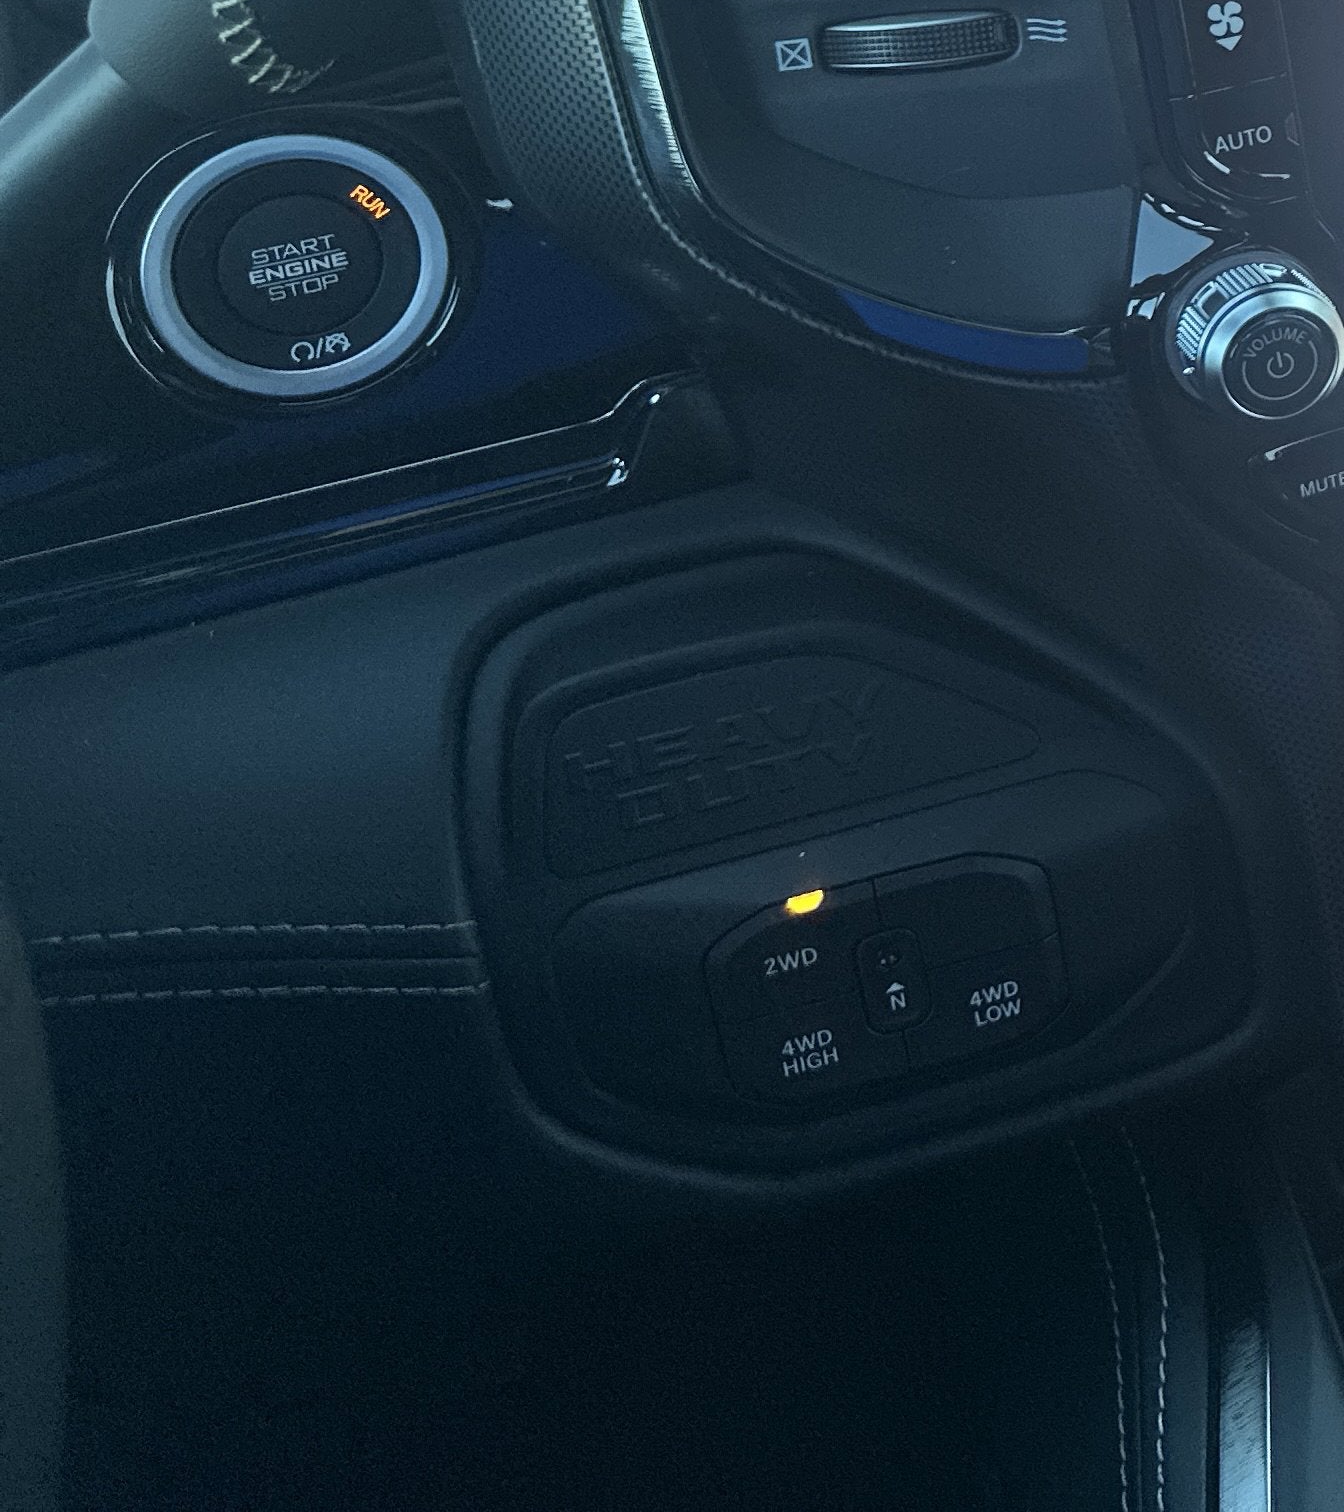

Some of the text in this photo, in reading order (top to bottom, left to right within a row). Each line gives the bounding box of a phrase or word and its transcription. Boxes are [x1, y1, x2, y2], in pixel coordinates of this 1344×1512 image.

[1214, 125, 1273, 155] AUTO
[350, 184, 391, 220] RUN
[251, 234, 335, 265] START
[249, 251, 349, 285] ENGINE
[268, 274, 339, 302] STOP
[1243, 327, 1308, 358] VOLUME
[764, 946, 818, 977] 2WD
[890, 992, 906, 1011] N
[970, 980, 1019, 1010] 4WD
[974, 997, 1023, 1027] LOW
[781, 1028, 833, 1058] 4WD
[782, 1047, 839, 1077] HIGH
